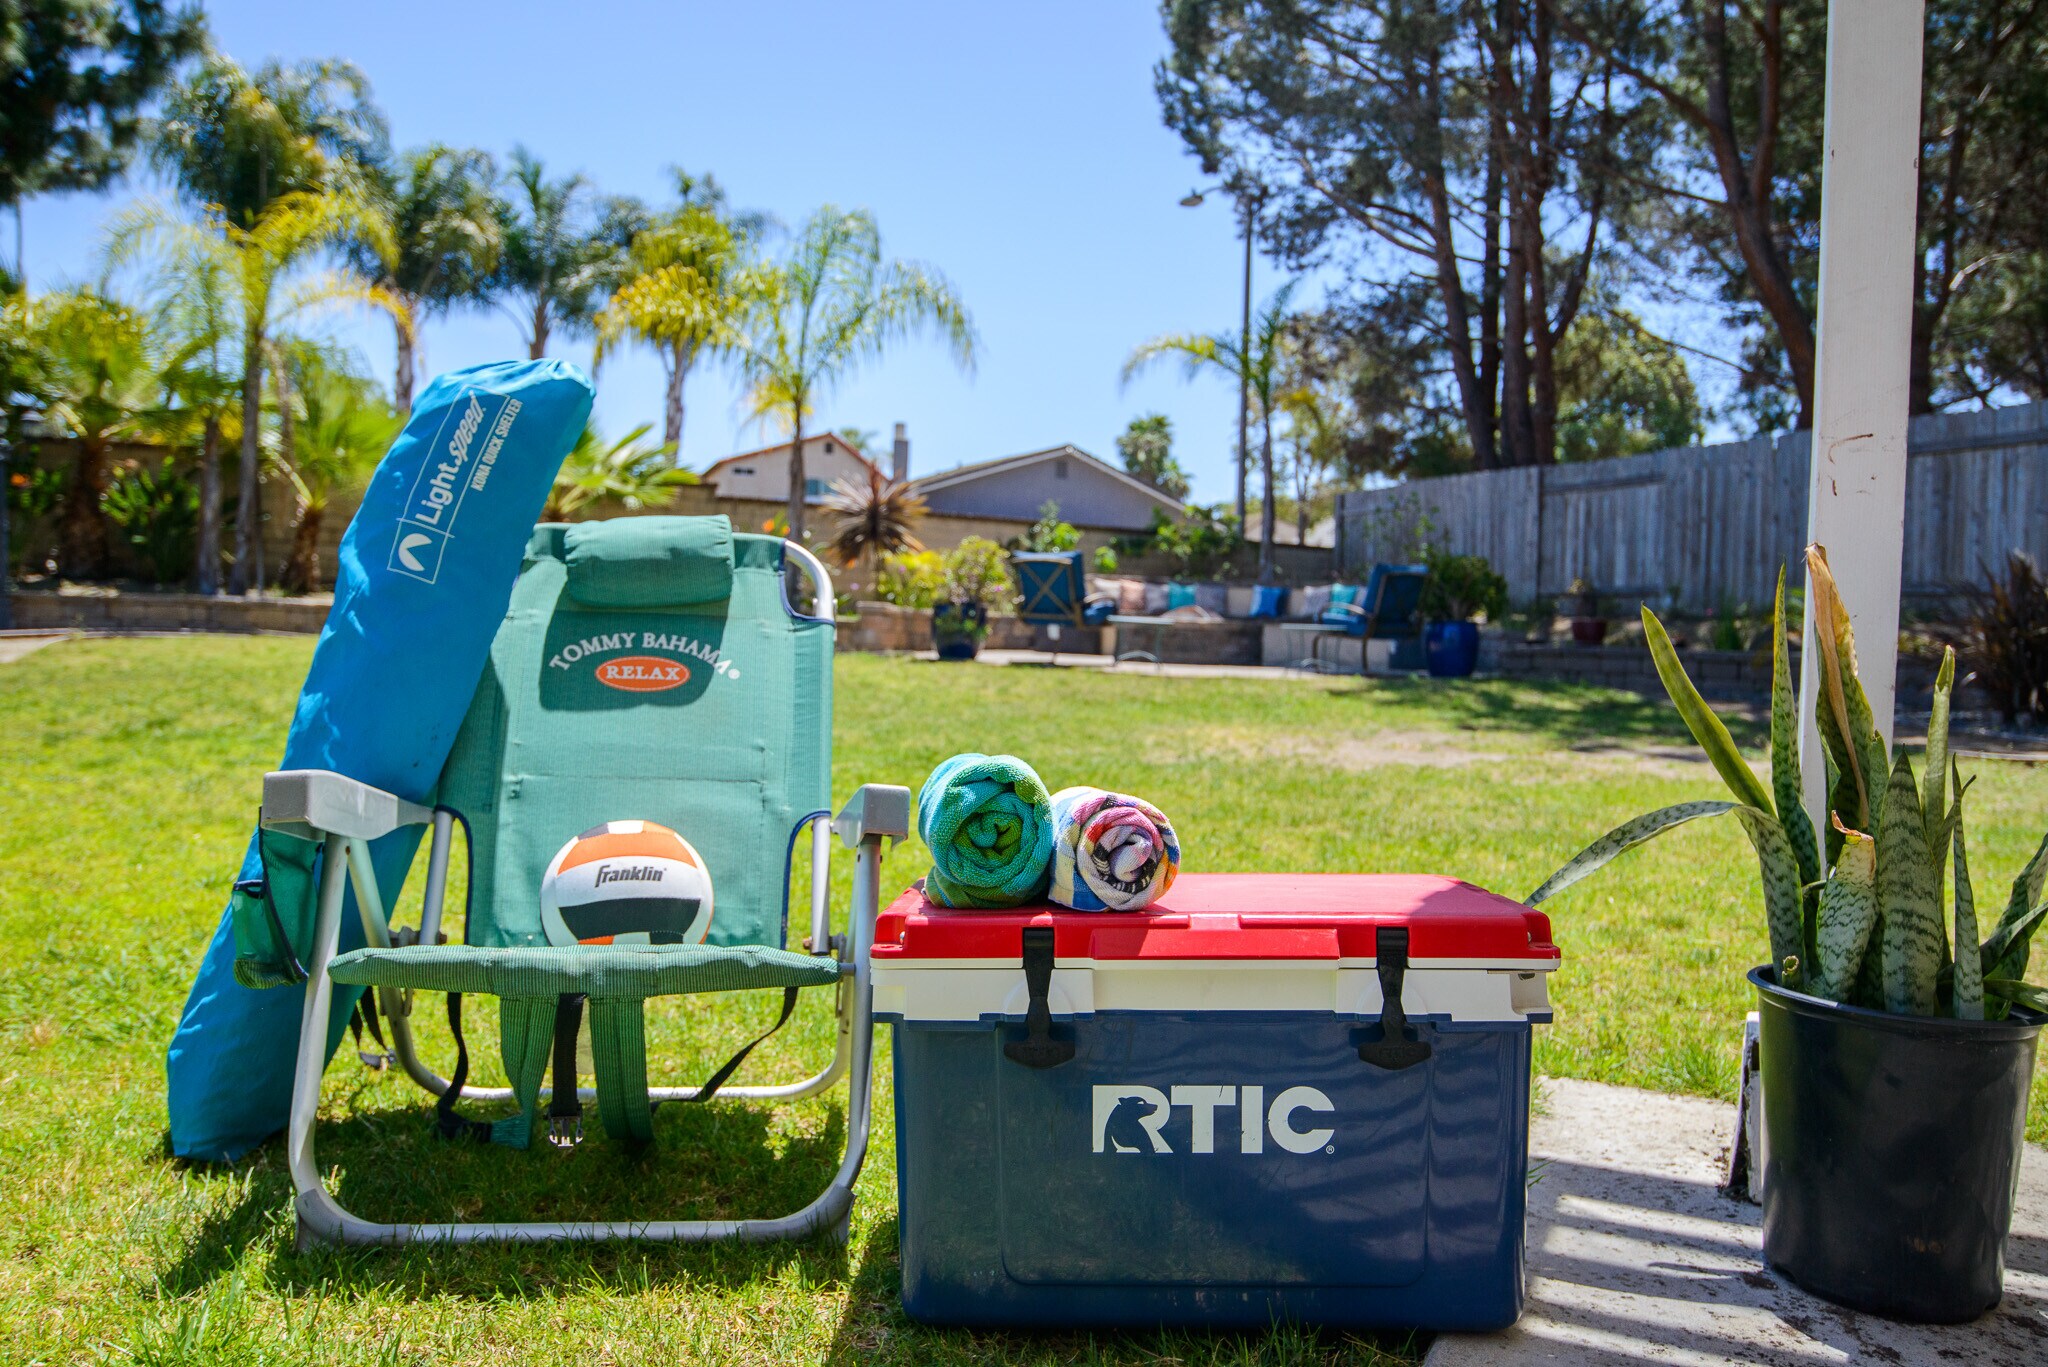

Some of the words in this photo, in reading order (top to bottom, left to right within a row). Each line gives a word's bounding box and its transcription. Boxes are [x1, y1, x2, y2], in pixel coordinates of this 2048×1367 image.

[470, 464, 493, 491] KONA
[482, 435, 505, 465] QUICK
[495, 398, 523, 437] SHELTER
[549, 632, 636, 671] TOMMY
[643, 632, 732, 675] BAHAMA
[605, 665, 681, 681] RELAX
